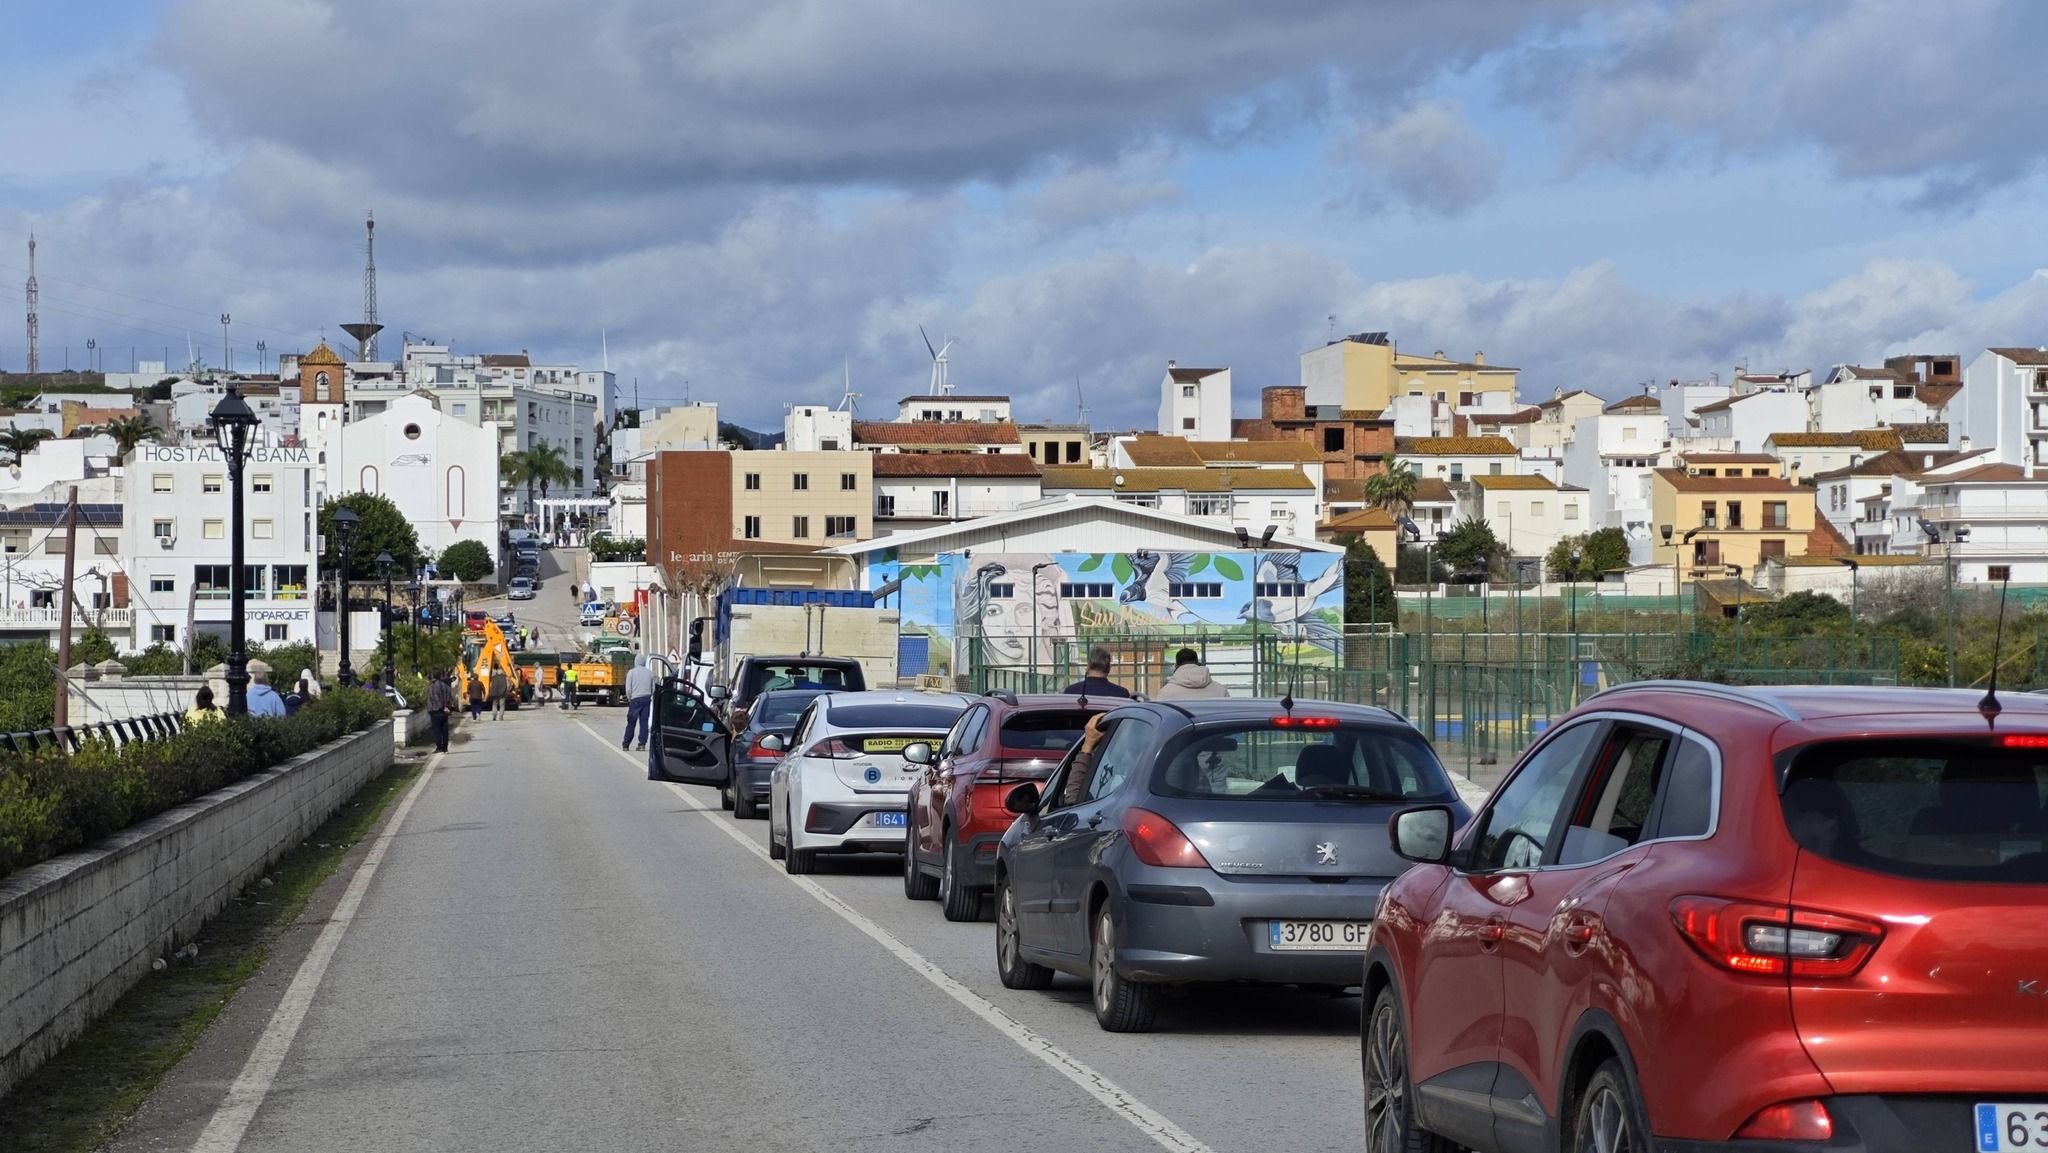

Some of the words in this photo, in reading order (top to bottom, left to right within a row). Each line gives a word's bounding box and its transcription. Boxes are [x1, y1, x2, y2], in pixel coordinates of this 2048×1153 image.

[145, 447, 221, 462] HOSTAL
[242, 447, 310, 463] ABANA
[670, 550, 713, 566] legaria
[717, 551, 739, 559] CENT
[1081, 601, 1116, 627] San
[619, 623, 630, 631] 30
[925, 677, 942, 688] TAXI
[867, 740, 893, 751] RADIO
[868, 770, 878, 781] B
[883, 814, 905, 825] 641
[1285, 923, 1334, 942] 3780
[1343, 923, 1368, 943] GF
